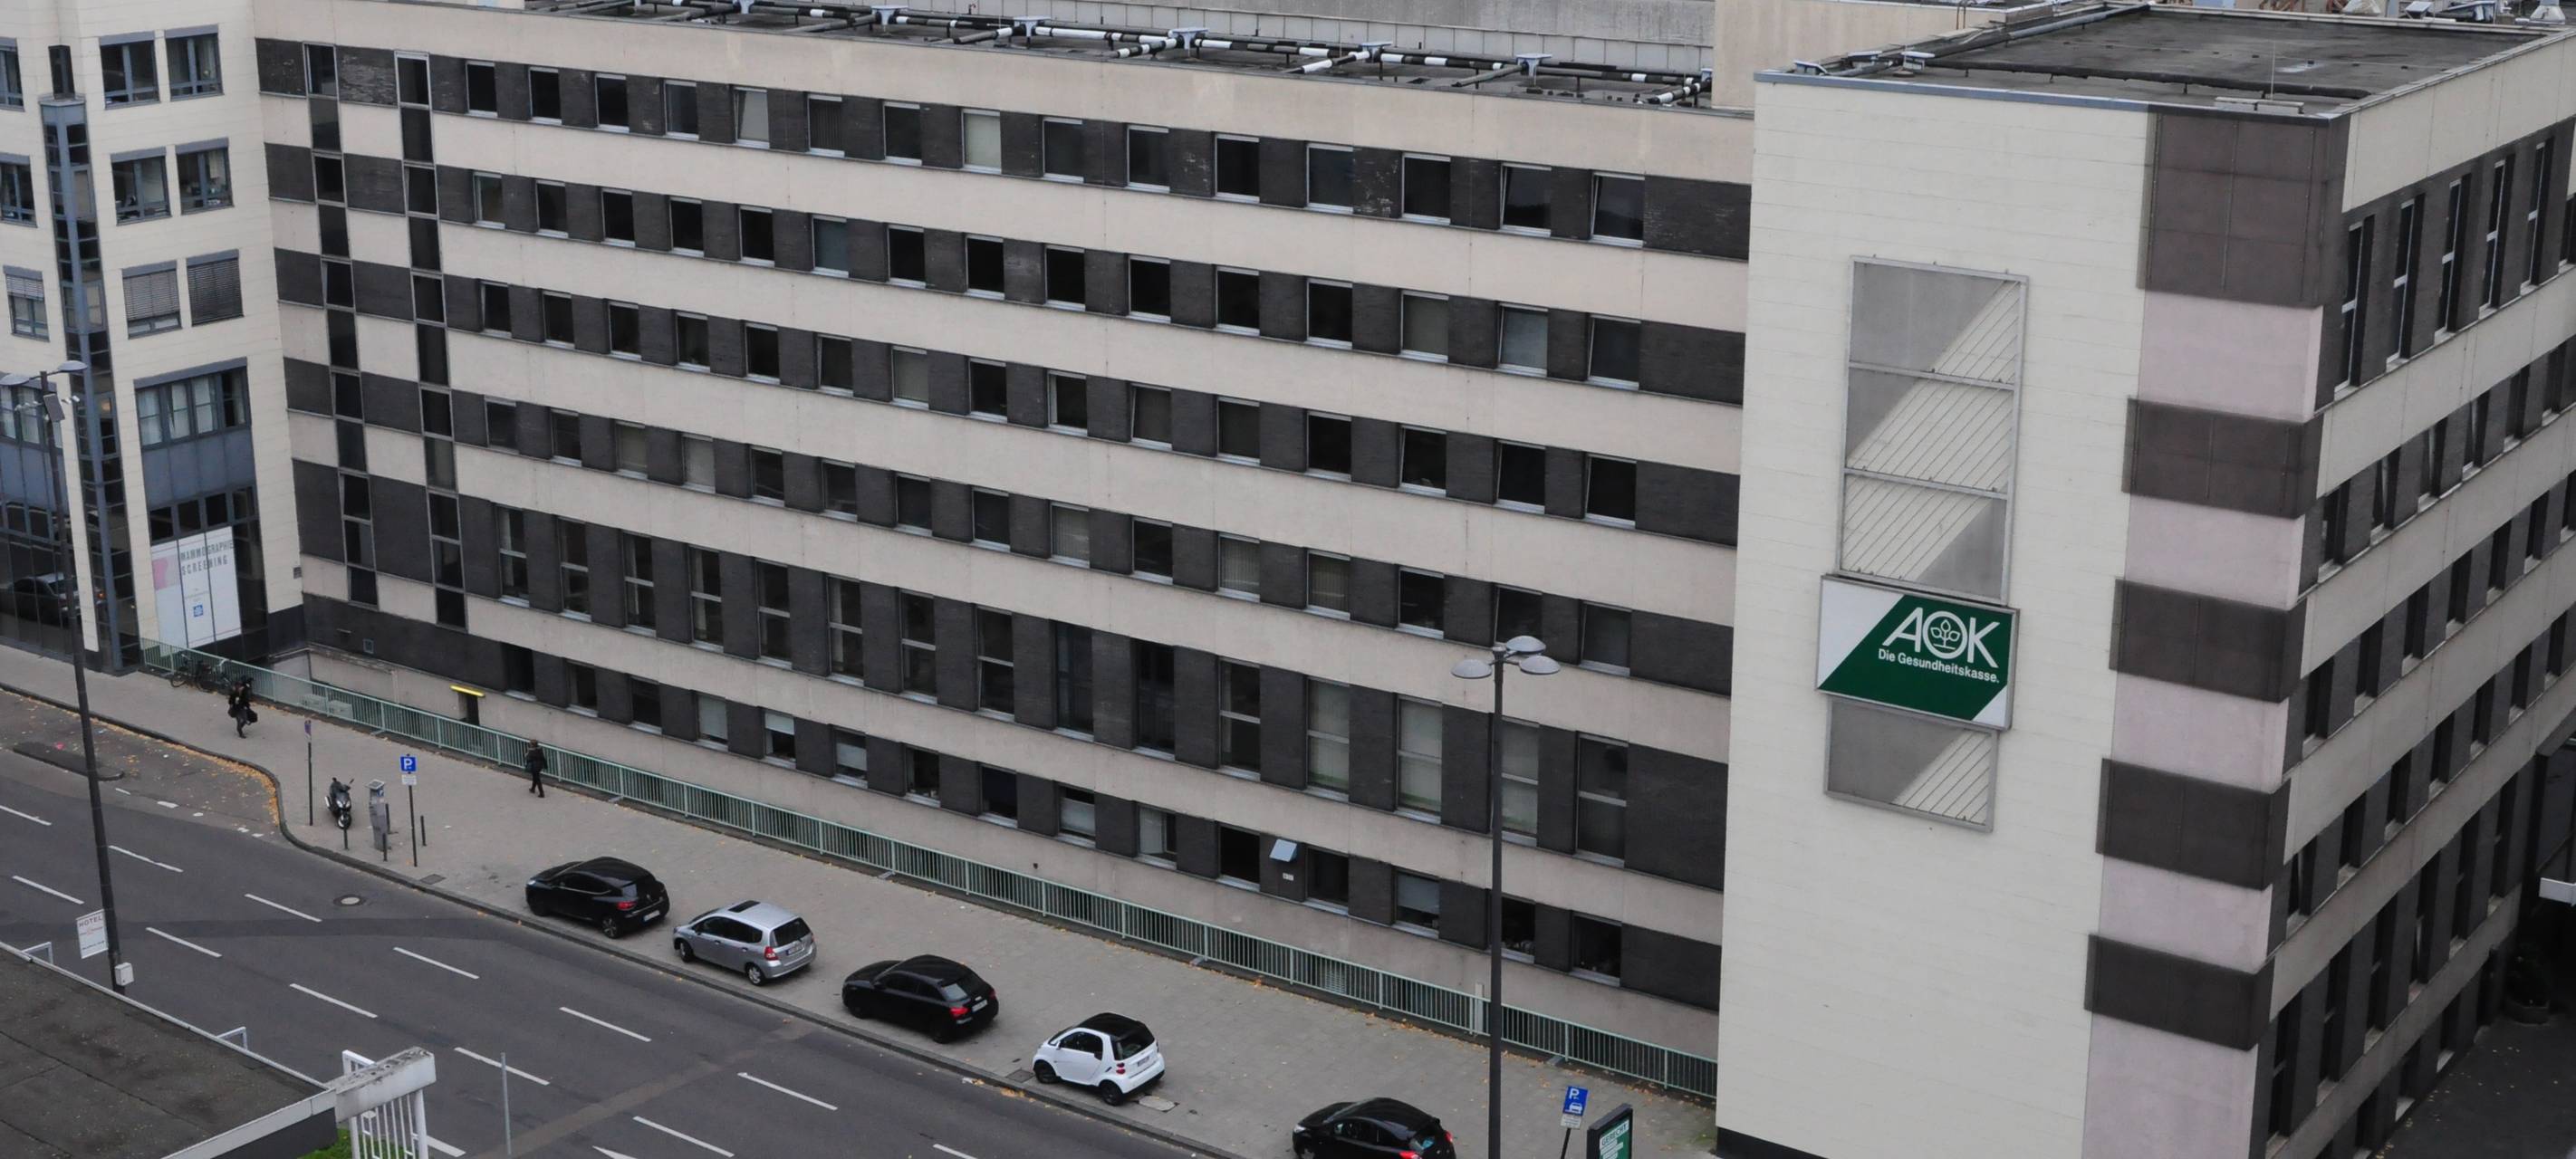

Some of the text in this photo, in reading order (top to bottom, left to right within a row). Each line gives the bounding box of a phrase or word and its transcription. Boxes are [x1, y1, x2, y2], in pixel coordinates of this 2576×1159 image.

[181, 554, 228, 576] SCREENING
[1881, 607, 2001, 668] AOK
[1878, 647, 2000, 684] Die Gesundheitskasse.
[403, 758, 413, 770] P
[78, 915, 103, 928] HOTEL
[1569, 1087, 1580, 1099] P
